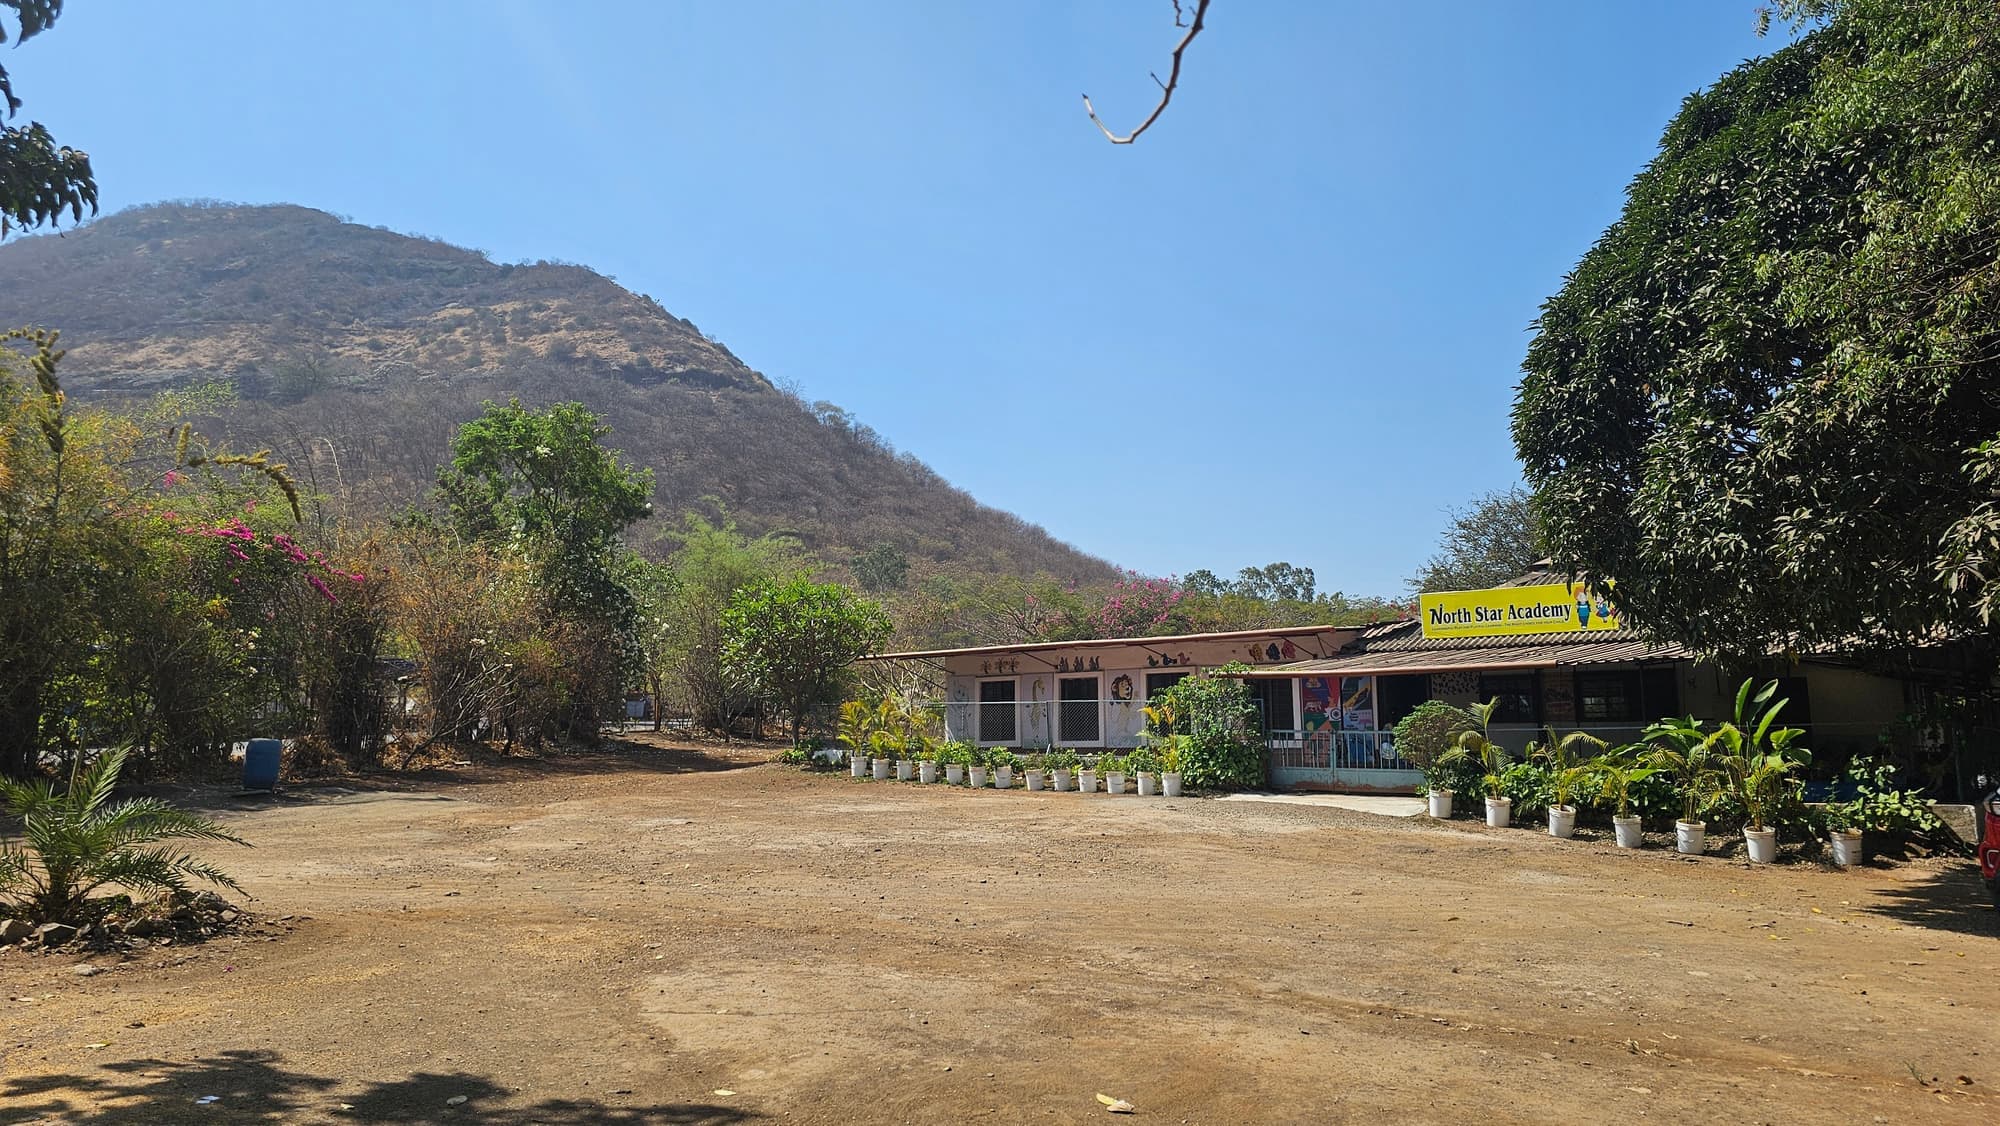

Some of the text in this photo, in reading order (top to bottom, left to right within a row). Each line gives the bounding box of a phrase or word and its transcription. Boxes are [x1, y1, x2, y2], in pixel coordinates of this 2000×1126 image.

[1430, 602, 1571, 624] North Star Academy
